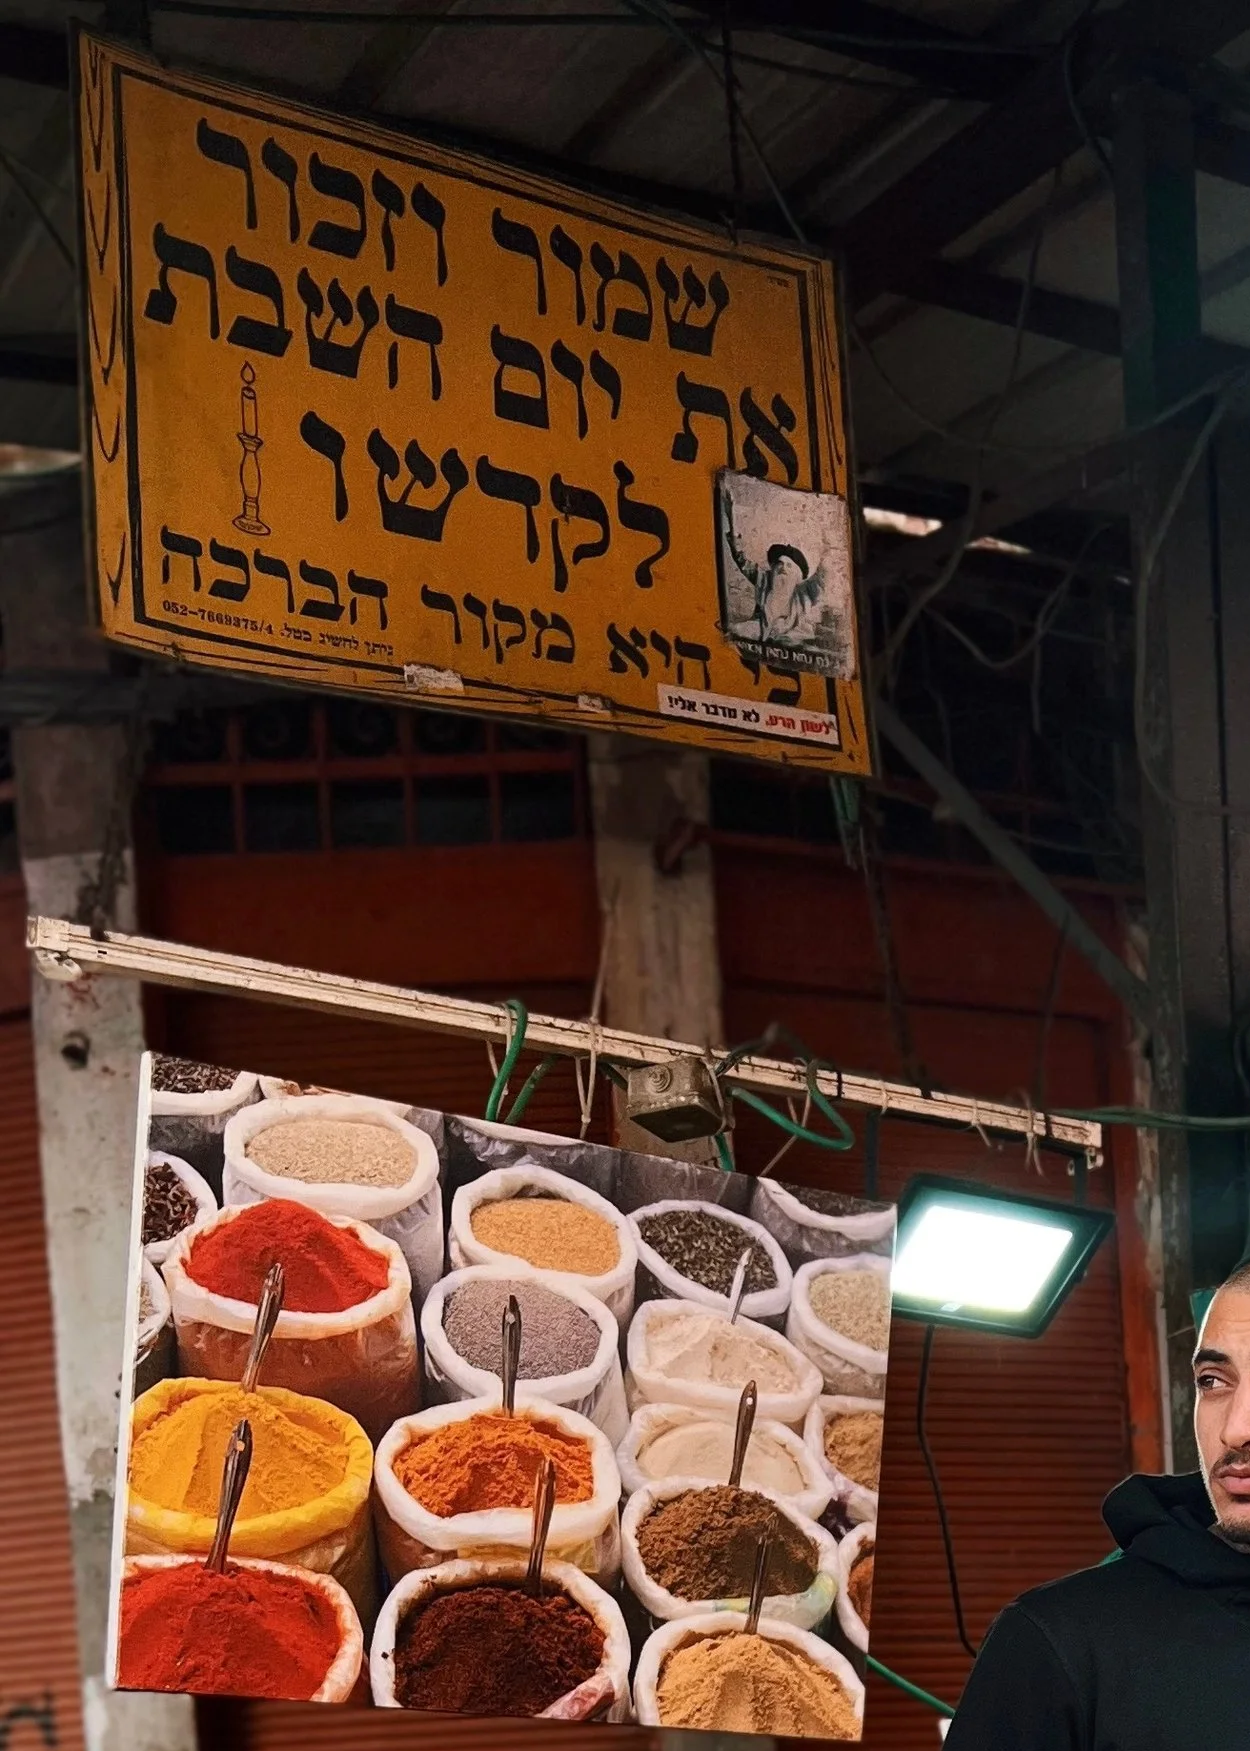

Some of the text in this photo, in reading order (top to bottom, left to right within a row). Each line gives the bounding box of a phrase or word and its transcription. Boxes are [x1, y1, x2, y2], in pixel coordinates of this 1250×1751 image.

[196, 117, 730, 358] שמור וזכור
[143, 222, 799, 486] את יום השבת
[300, 411, 673, 593] לקדשו
[159, 526, 390, 631] הברכה
[420, 584, 577, 666] מקור
[606, 621, 712, 692] היא
[667, 695, 697, 713] אלי!
[701, 703, 738, 720] מדבר
[742, 708, 760, 723] לא
